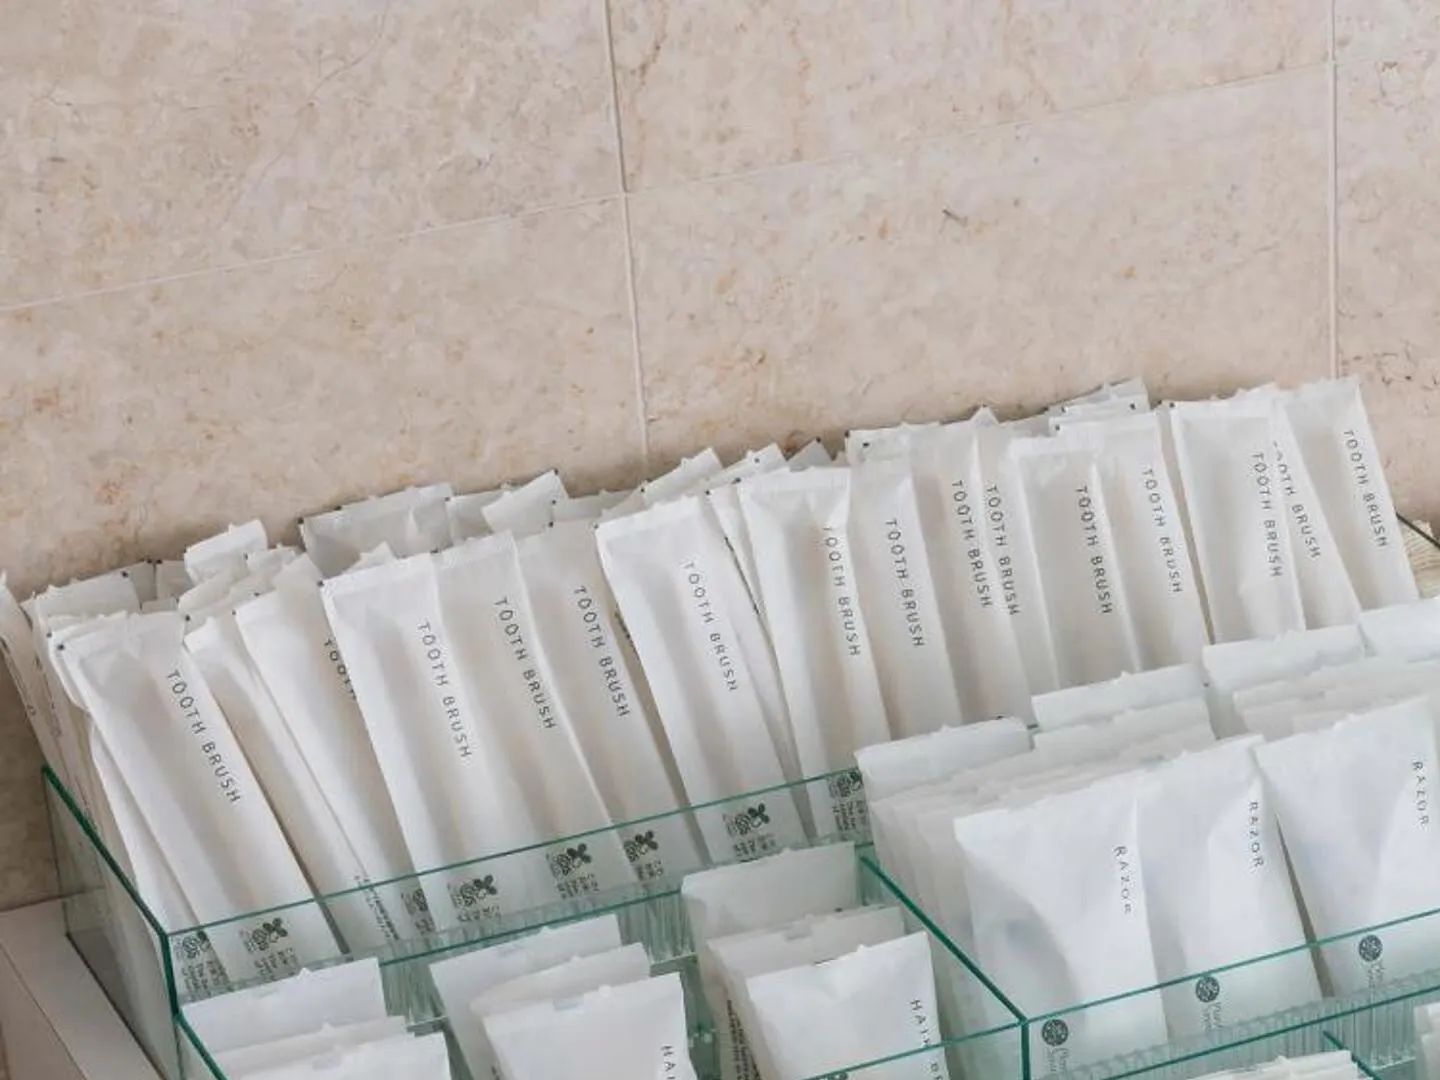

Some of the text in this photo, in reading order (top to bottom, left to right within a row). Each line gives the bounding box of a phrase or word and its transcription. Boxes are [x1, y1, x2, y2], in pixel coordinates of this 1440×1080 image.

[952, 480, 993, 608] TOOTH BRUSH
[987, 484, 1021, 616] TOOTH BRUSH
[1075, 485, 1113, 615] TOOTH BRUSH
[1141, 467, 1182, 594] TOOTH BRUSH
[1252, 452, 1283, 577] TOOTH BRUSH
[1291, 503, 1322, 558] BRUSH
[1343, 429, 1389, 548] TOOTH BRUSH
[681, 560, 738, 692] TOOTH BRUSH
[822, 525, 861, 657] TOOTH BRUSH
[885, 517, 926, 647] TOOTH BRUSH
[418, 621, 472, 759] TOOTH BRUSH
[494, 596, 557, 729] TOOTH BRUSH
[573, 585, 605, 648] TOOTH
[598, 655, 631, 717] BRUSH
[166, 668, 242, 803] TOOTH BRUSH
[1412, 760, 1430, 825] RAZOR
[1113, 845, 1133, 915] RAZOR
